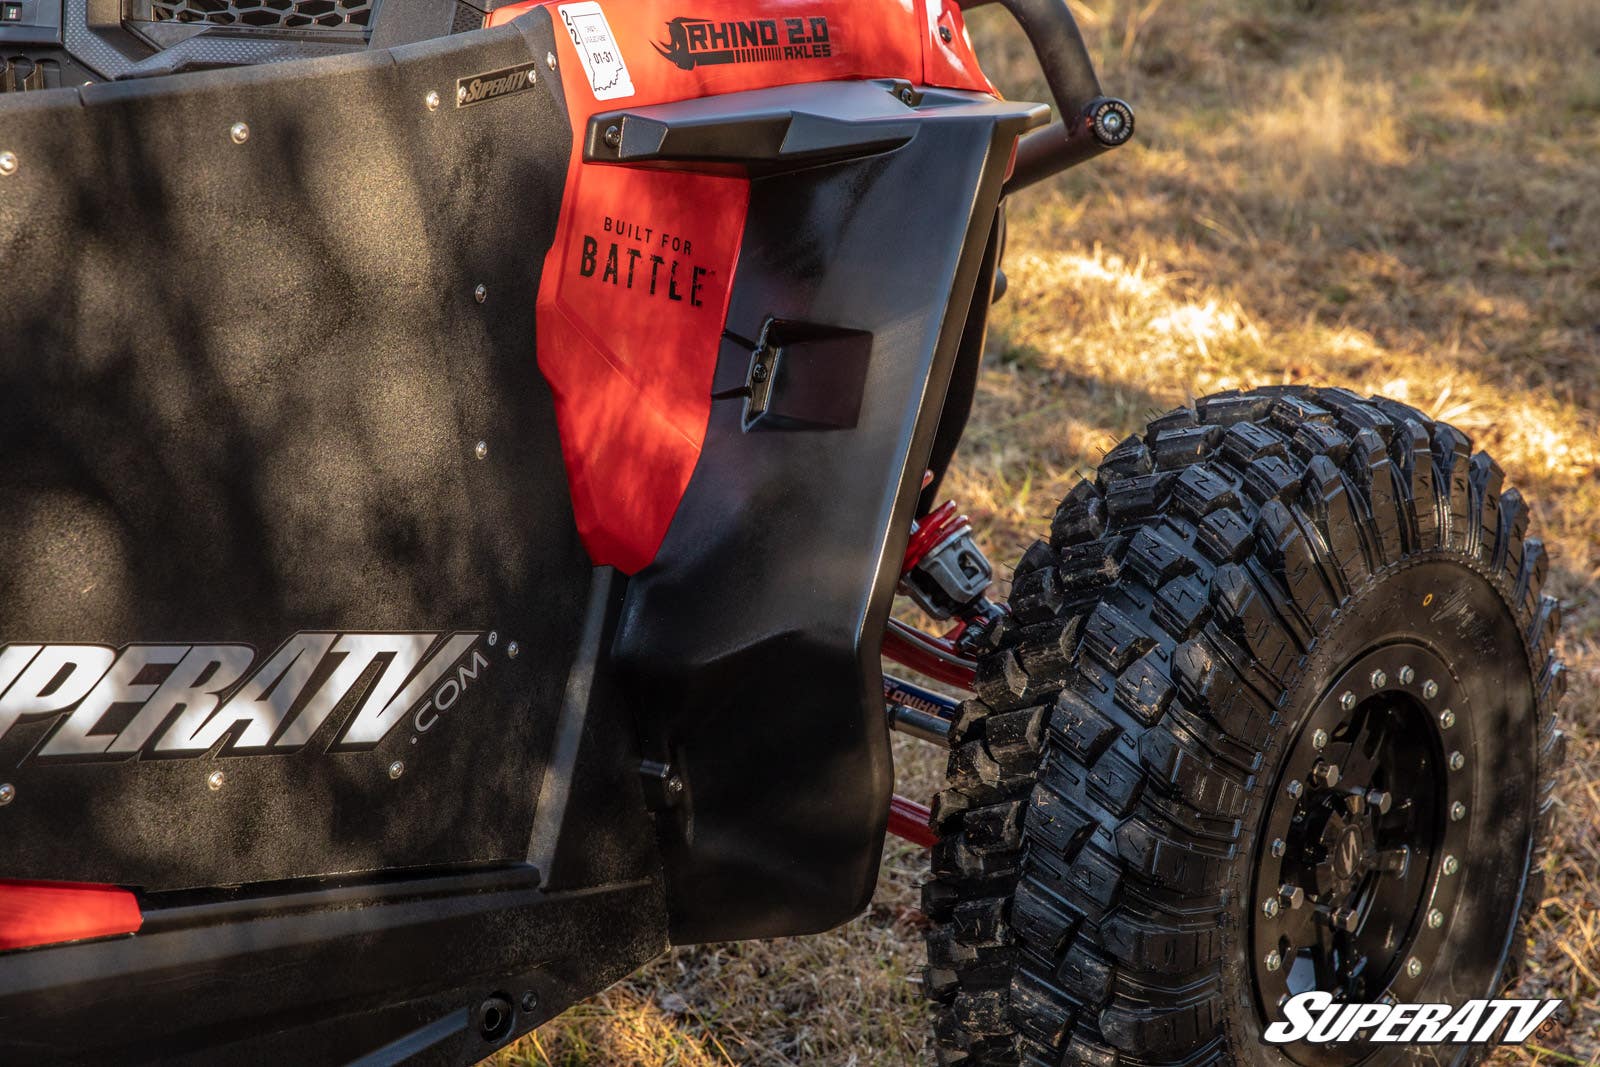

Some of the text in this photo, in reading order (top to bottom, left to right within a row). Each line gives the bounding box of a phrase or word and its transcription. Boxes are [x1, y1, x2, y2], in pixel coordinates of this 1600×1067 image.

[686, 16, 830, 51] RHINO 2.0
[592, 51, 614, 64] 01-31
[784, 44, 832, 61] AXLES
[465, 70, 529, 103] SUPERATV
[603, 216, 693, 256] BUILT FOR
[579, 234, 707, 307] BATTLE
